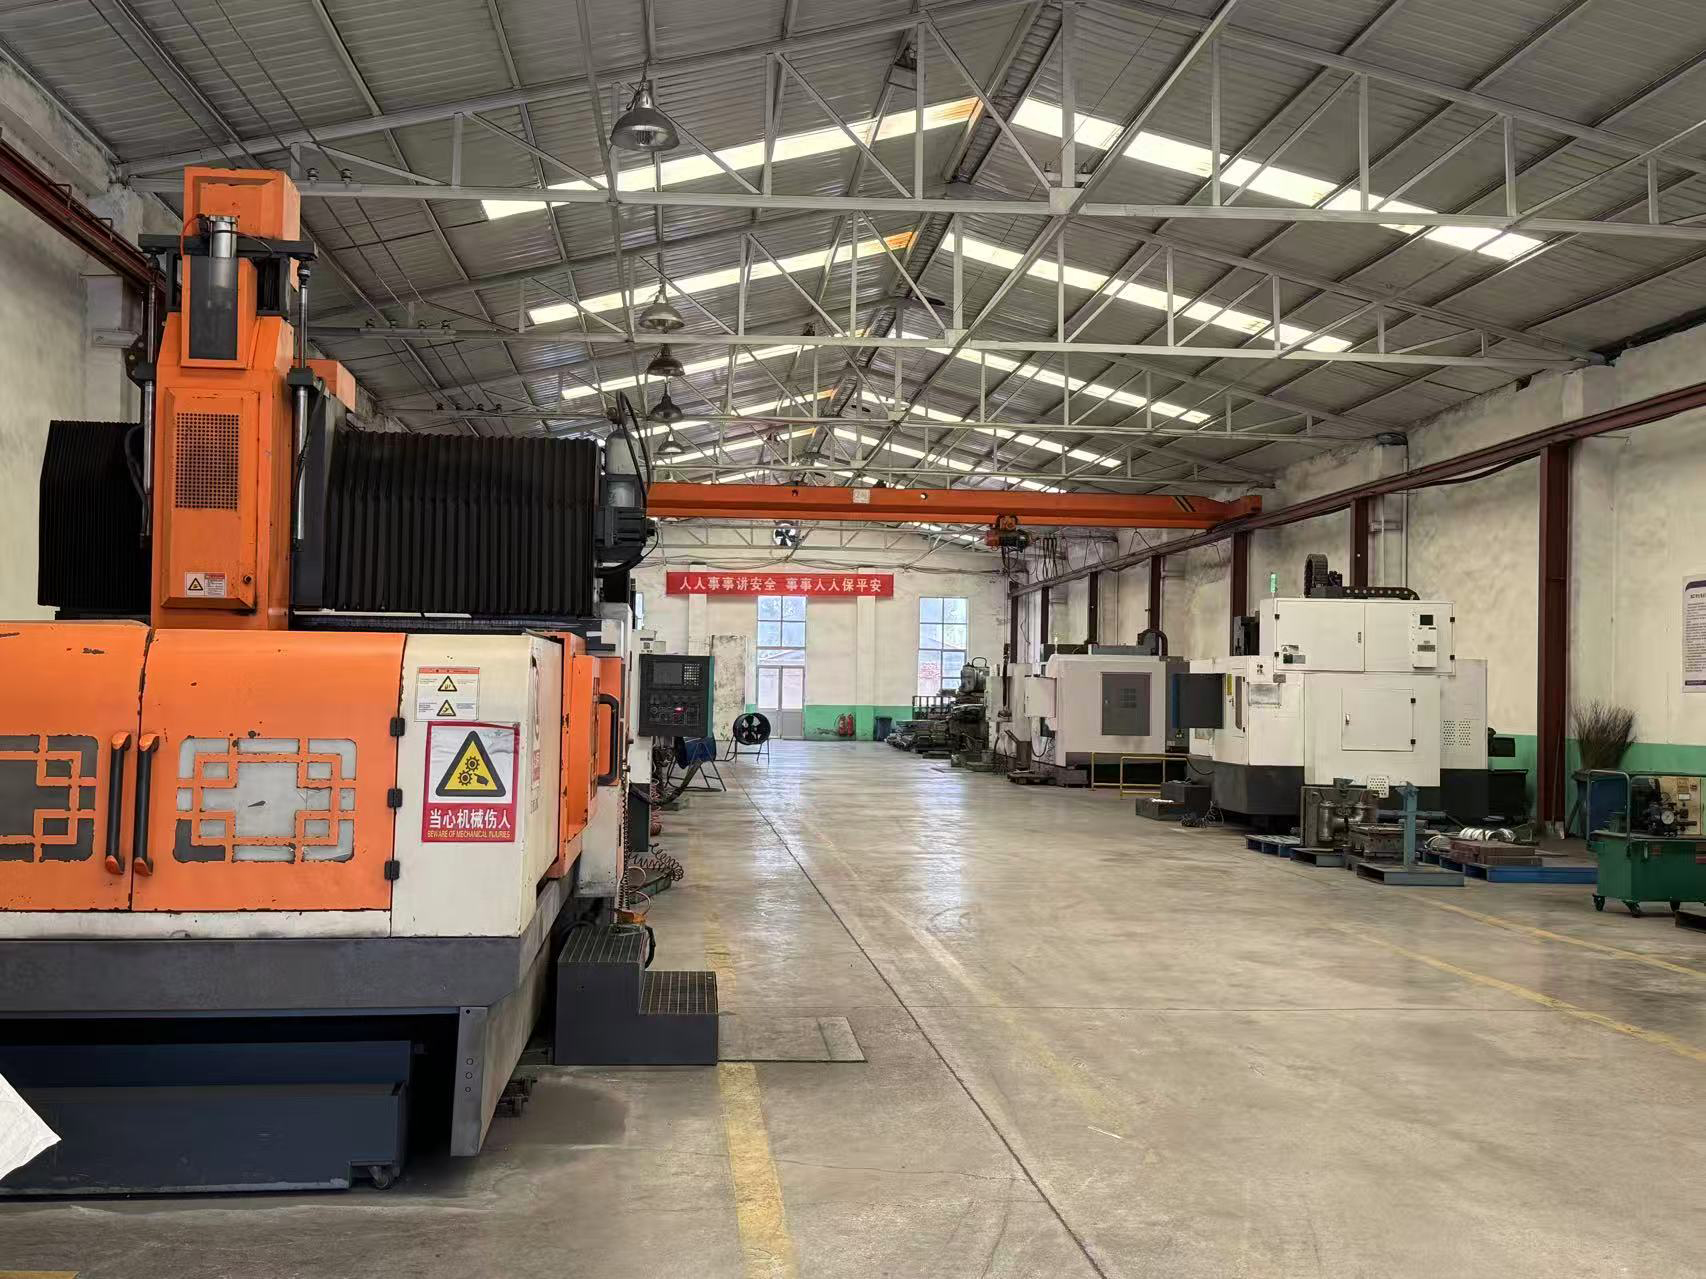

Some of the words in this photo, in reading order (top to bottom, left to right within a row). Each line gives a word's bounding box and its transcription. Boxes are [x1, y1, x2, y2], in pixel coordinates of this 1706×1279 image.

[680, 576, 777, 591] 人人事事讲安全
[785, 577, 882, 592] 事事人人保平安
[429, 808, 511, 829] 当心机械伤人
[427, 830, 448, 838] BEWARE
[448, 830, 456, 838] OF
[456, 830, 487, 838] MECHANICAL
[488, 830, 511, 838] INJURIES
